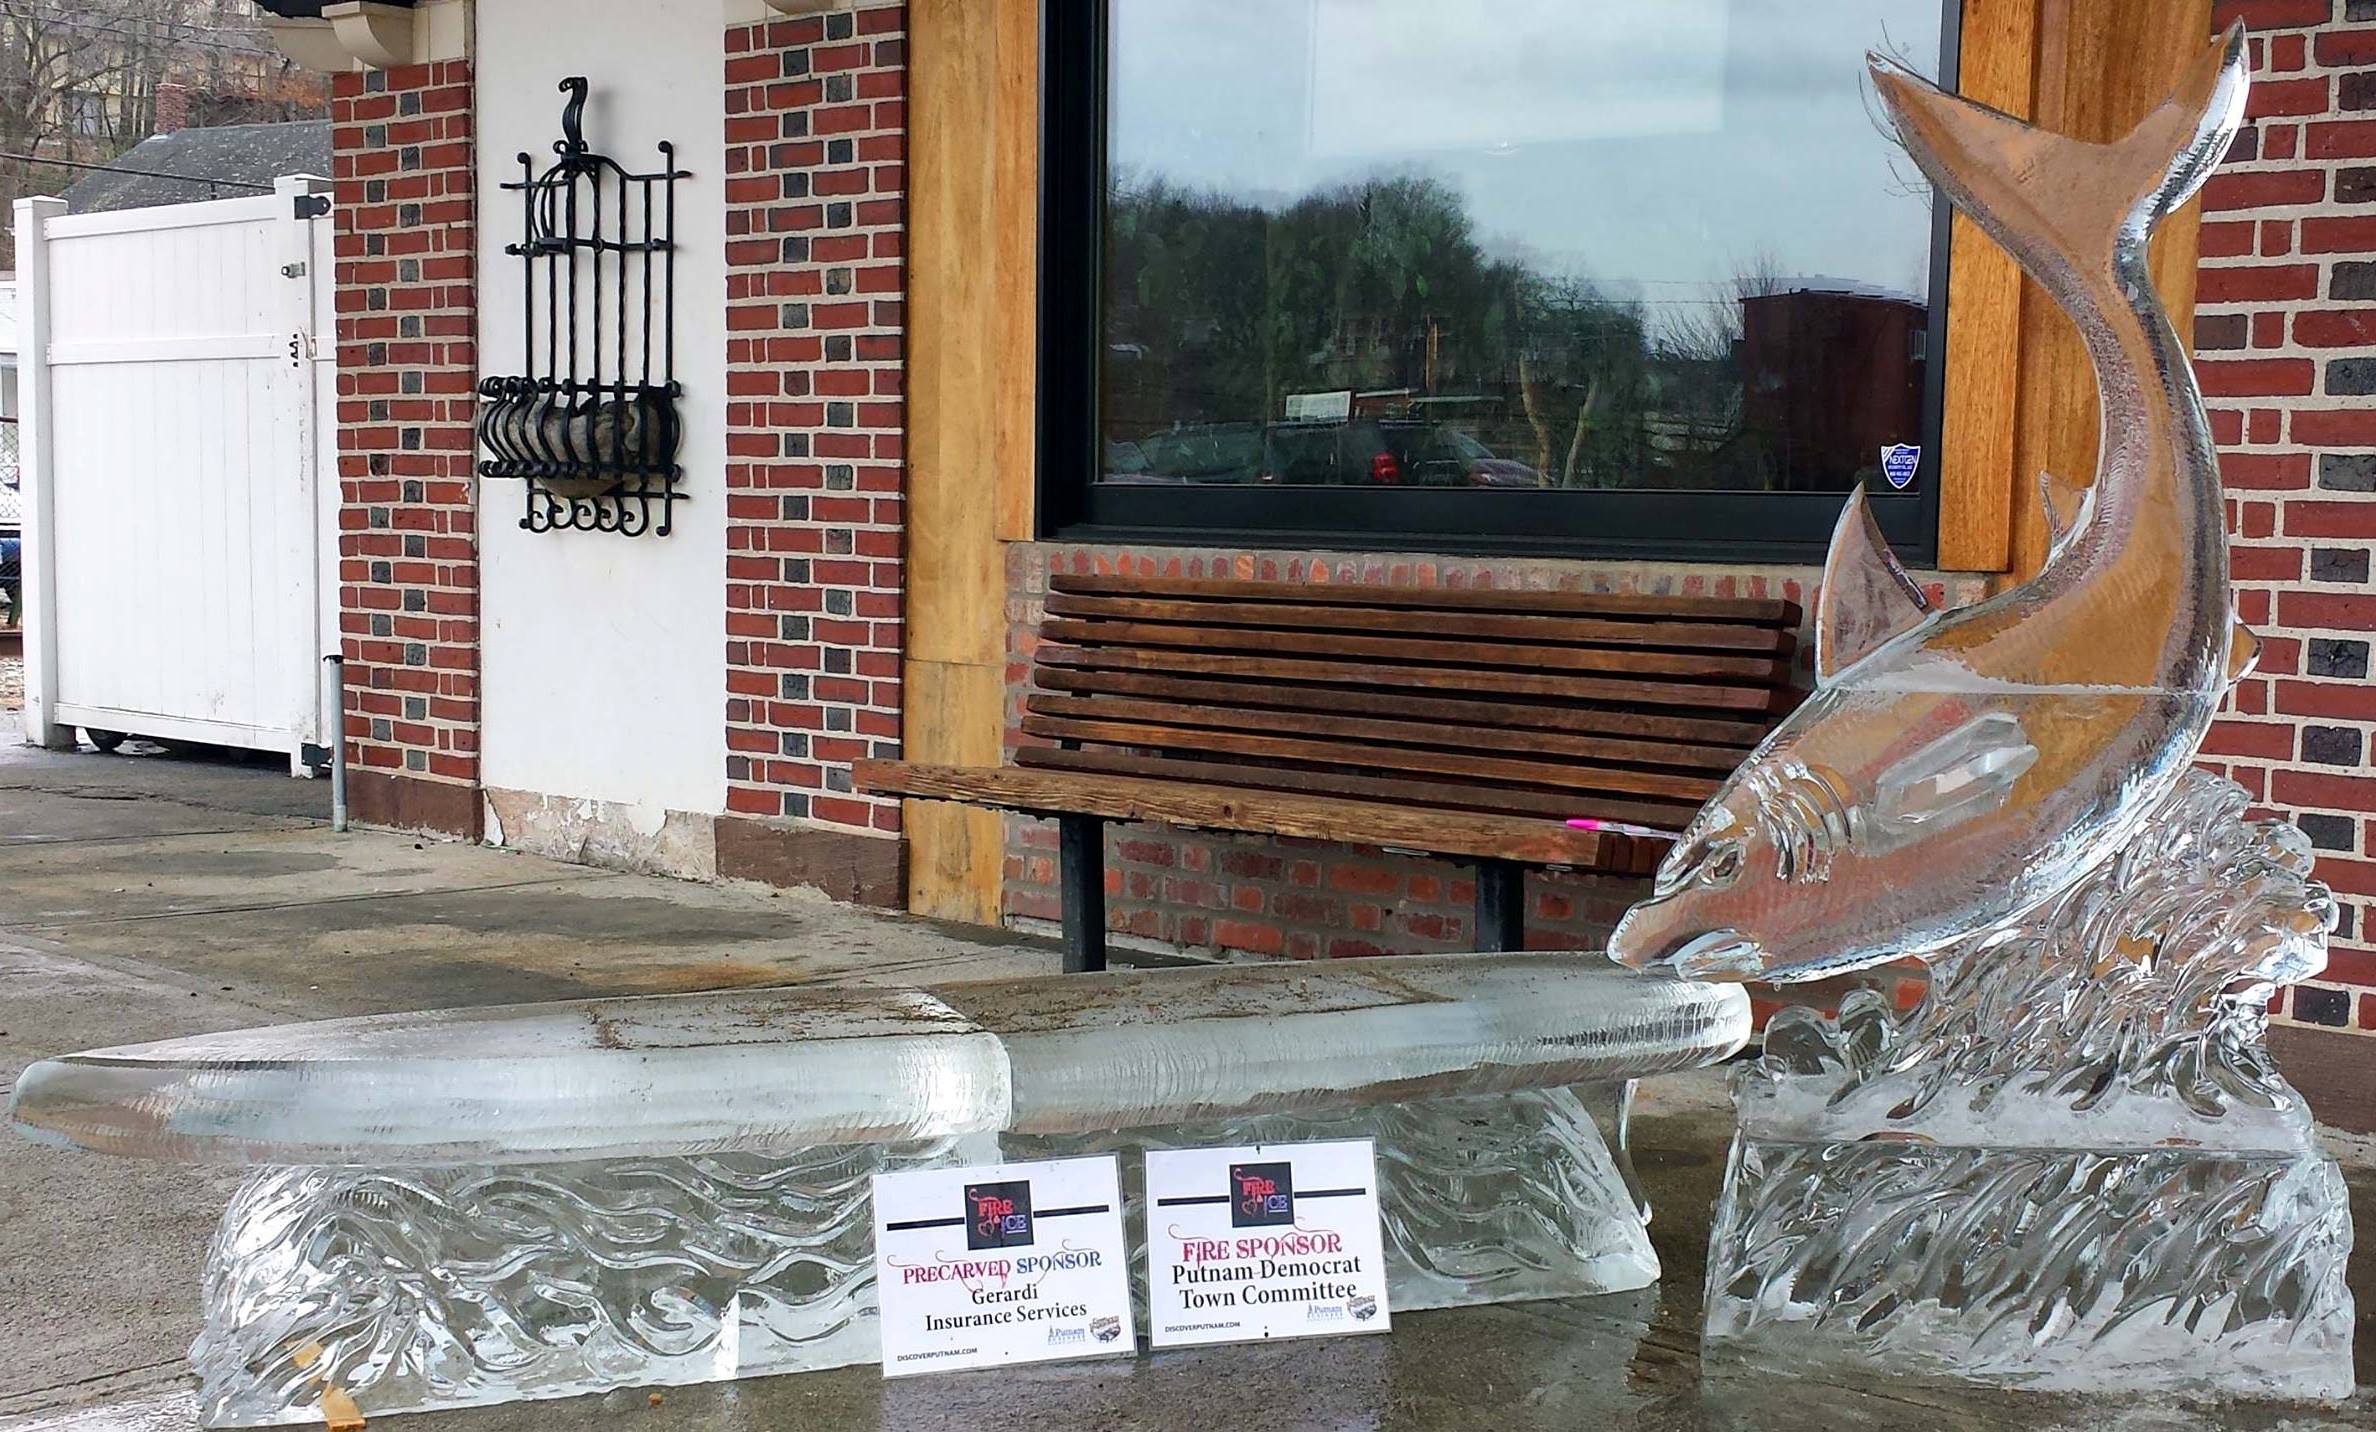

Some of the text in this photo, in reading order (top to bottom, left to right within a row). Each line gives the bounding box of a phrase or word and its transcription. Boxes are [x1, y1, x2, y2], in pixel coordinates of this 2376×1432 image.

[1242, 1180, 1275, 1195] FIRE
[978, 1199, 1014, 1216] FIRE
[1264, 1195, 1288, 1211] ICE
[1001, 1214, 1027, 1231] ICE
[1182, 1232, 1343, 1264] FIRE SPONSOR
[903, 1251, 1102, 1286] PRECARVED SPONSOR
[1172, 1256, 1362, 1285] Putnam Democrat
[971, 1283, 1038, 1305] Gerardi
[1179, 1288, 1236, 1309] Town
[1241, 1282, 1357, 1305] Committee
[926, 1302, 1087, 1331] Insurance Services
[1164, 1321, 1241, 1333] DISCOVERPUTNAM.COM
[897, 1347, 978, 1362] DISCOVERPUTNAM.COM
